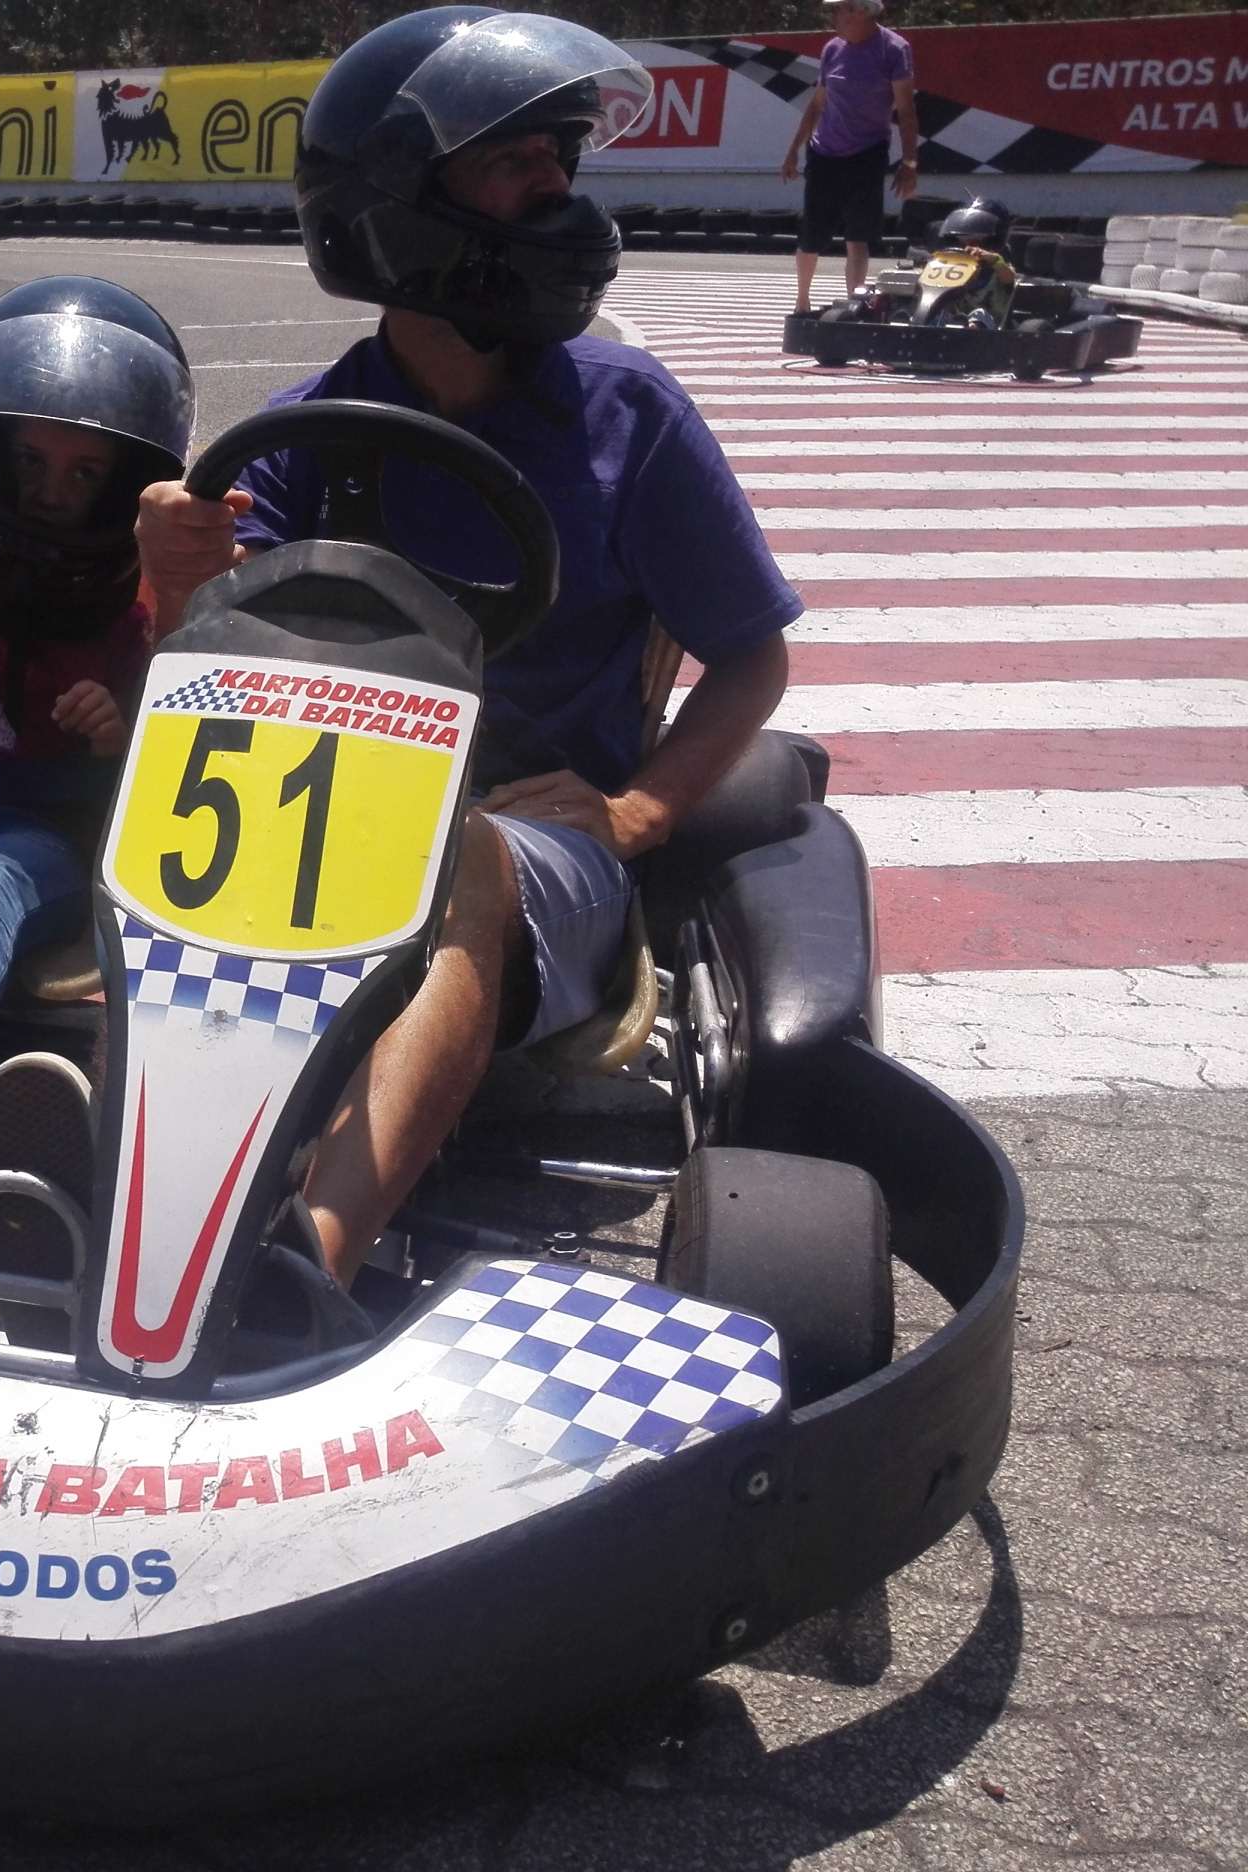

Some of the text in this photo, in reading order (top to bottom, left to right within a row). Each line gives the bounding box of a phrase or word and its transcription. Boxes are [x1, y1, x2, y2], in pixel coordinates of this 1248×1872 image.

[1046, 57, 1215, 90] CENTROS
[201, 96, 309, 176] en
[1121, 102, 1219, 131] ALTA
[216, 669, 460, 722] KARTÓDROMO
[241, 695, 460, 748] DA BATALHA
[160, 718, 339, 930] 51
[34, 1408, 445, 1517] BATALHA
